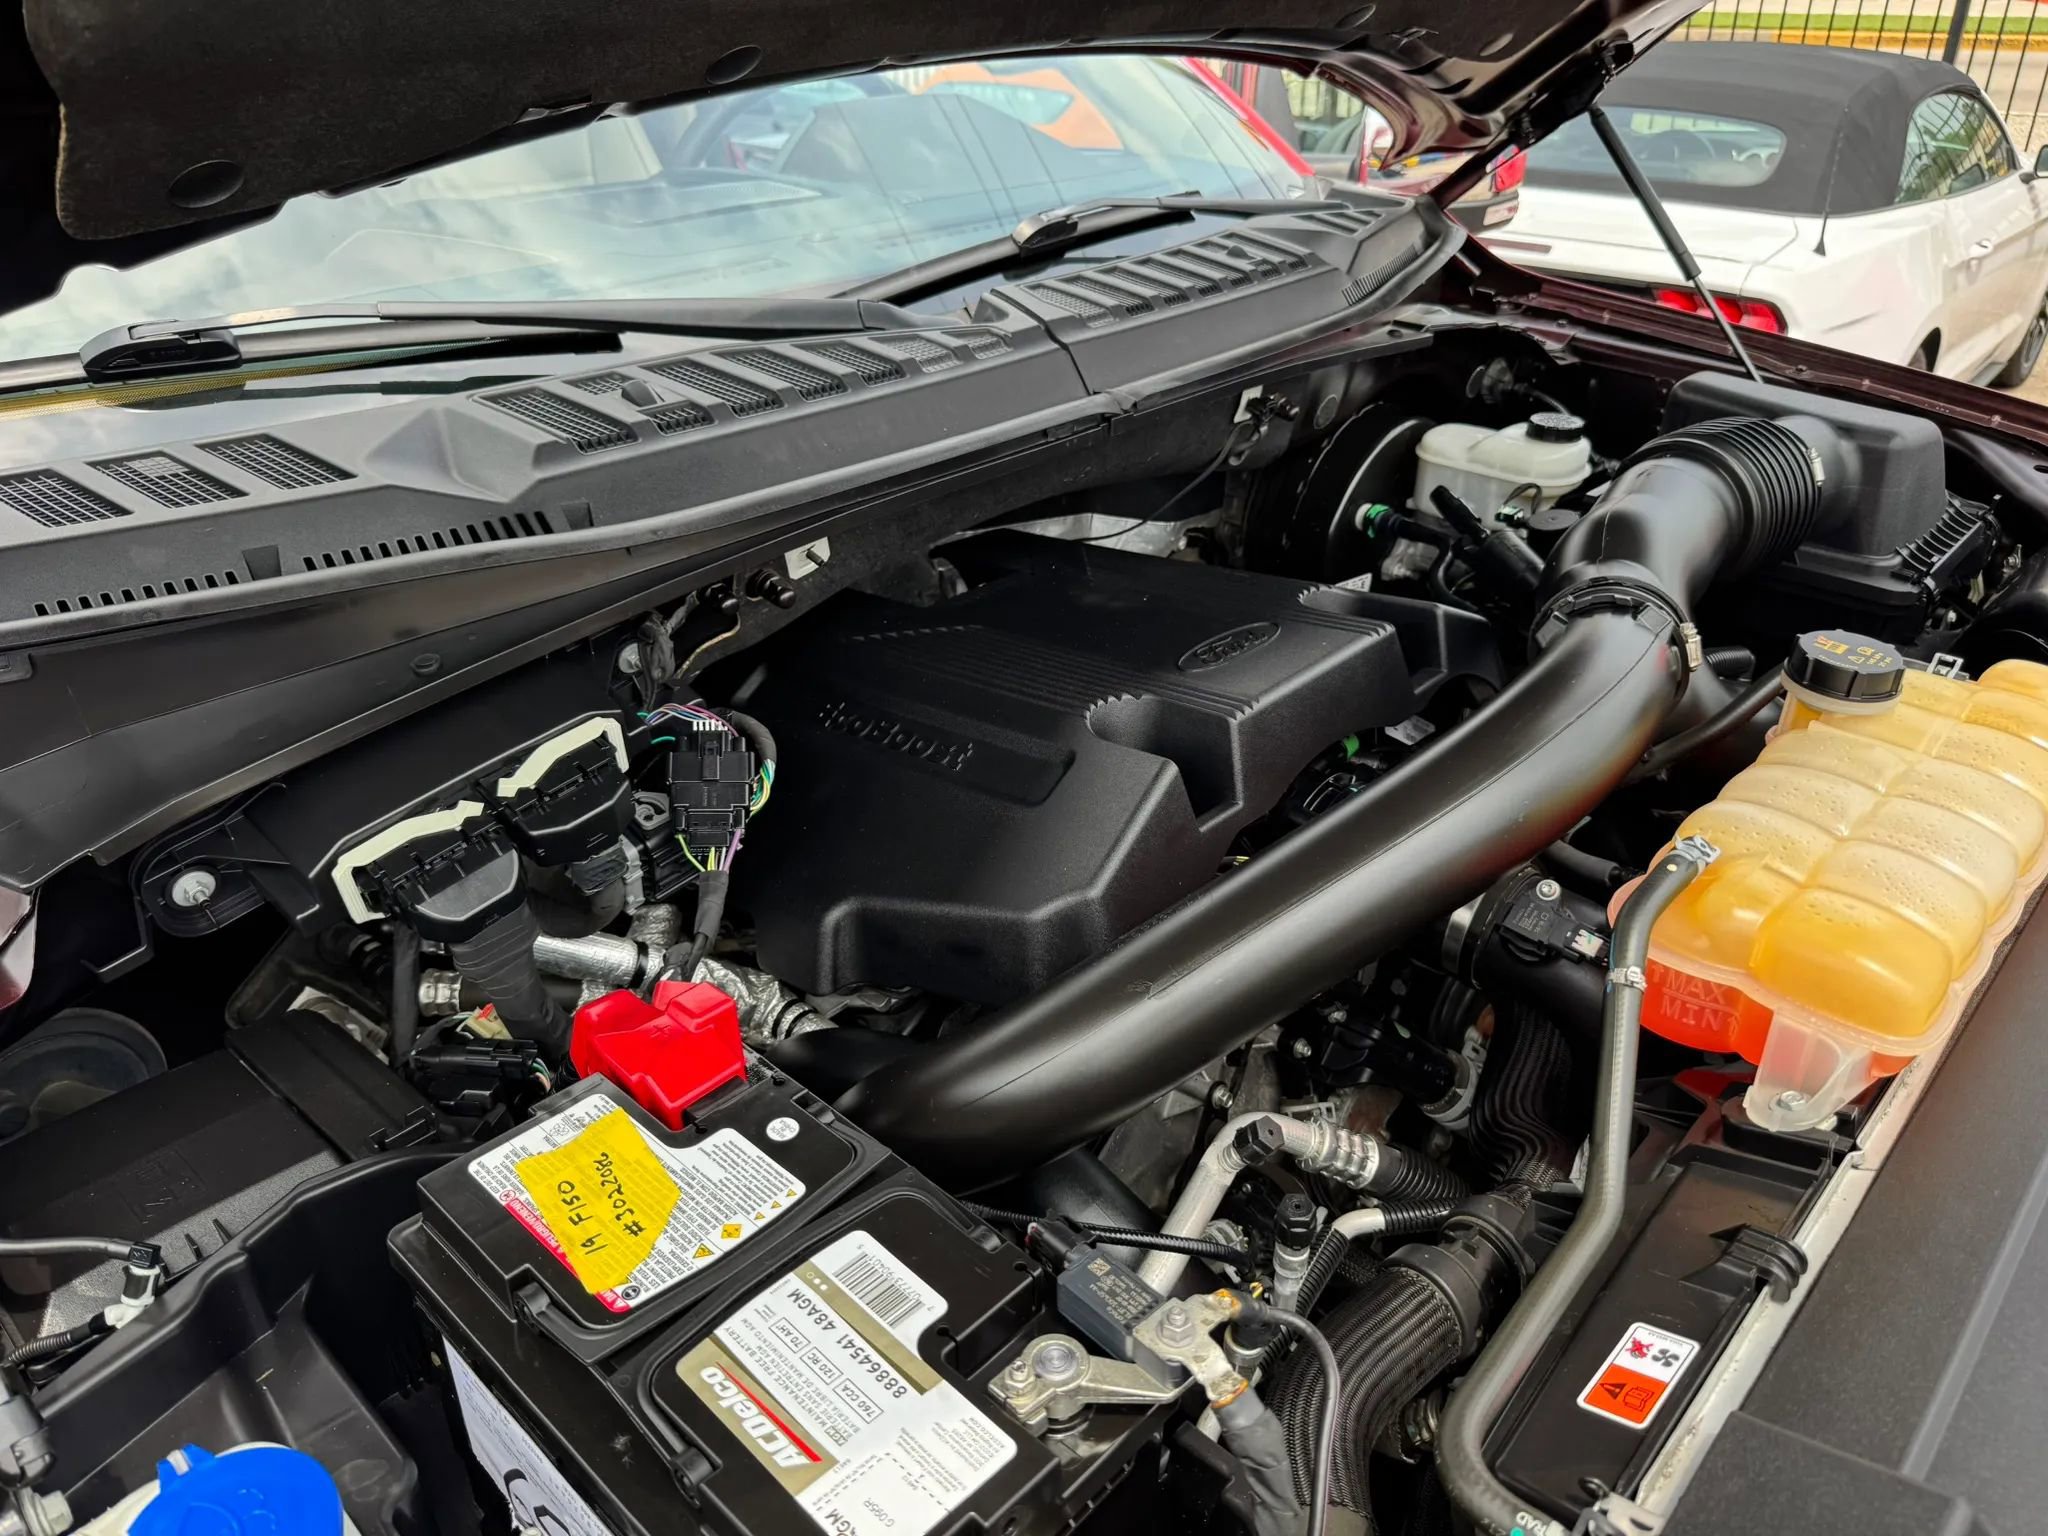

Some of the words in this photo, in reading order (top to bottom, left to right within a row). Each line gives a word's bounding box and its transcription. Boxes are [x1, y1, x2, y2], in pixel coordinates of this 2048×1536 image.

[1196, 632, 1268, 664] Ford
[1666, 970, 1727, 1004] MAX
[1661, 996, 1723, 1031] MIN
[489, 1184, 501, 1194] KEEP
[551, 1178, 593, 1226] F150
[684, 1213, 698, 1223] EYES
[578, 1231, 608, 1257] 19
[653, 1258, 677, 1279] PROTEJA
[654, 1248, 685, 1275] EXPLOSIVOS
[786, 1286, 837, 1335] 48AGM
[740, 1316, 756, 1331] AGM
[722, 1324, 758, 1358] BATTERY
[754, 1344, 771, 1360] AGM
[789, 1335, 804, 1348] 70
[753, 1329, 805, 1379] MANTENIMIENTO
[753, 1355, 776, 1376] FREE
[806, 1351, 822, 1365] RC
[767, 1357, 804, 1392] ENTRETIEN
[818, 1362, 836, 1379] 120
[835, 1331, 908, 1401] 88864541
[801, 1376, 814, 1388] DE
[839, 1383, 861, 1402] CCA
[772, 1374, 828, 1428] MAINTENANCE
[801, 1390, 822, 1409] SANS
[810, 1386, 833, 1407] LIBRE
[856, 1398, 876, 1417] 760
[701, 1365, 811, 1469] ACDelco
[819, 1407, 854, 1440] BATTERIE
[824, 1425, 847, 1446] AGM
[1512, 1509, 1549, 1536] RAD
